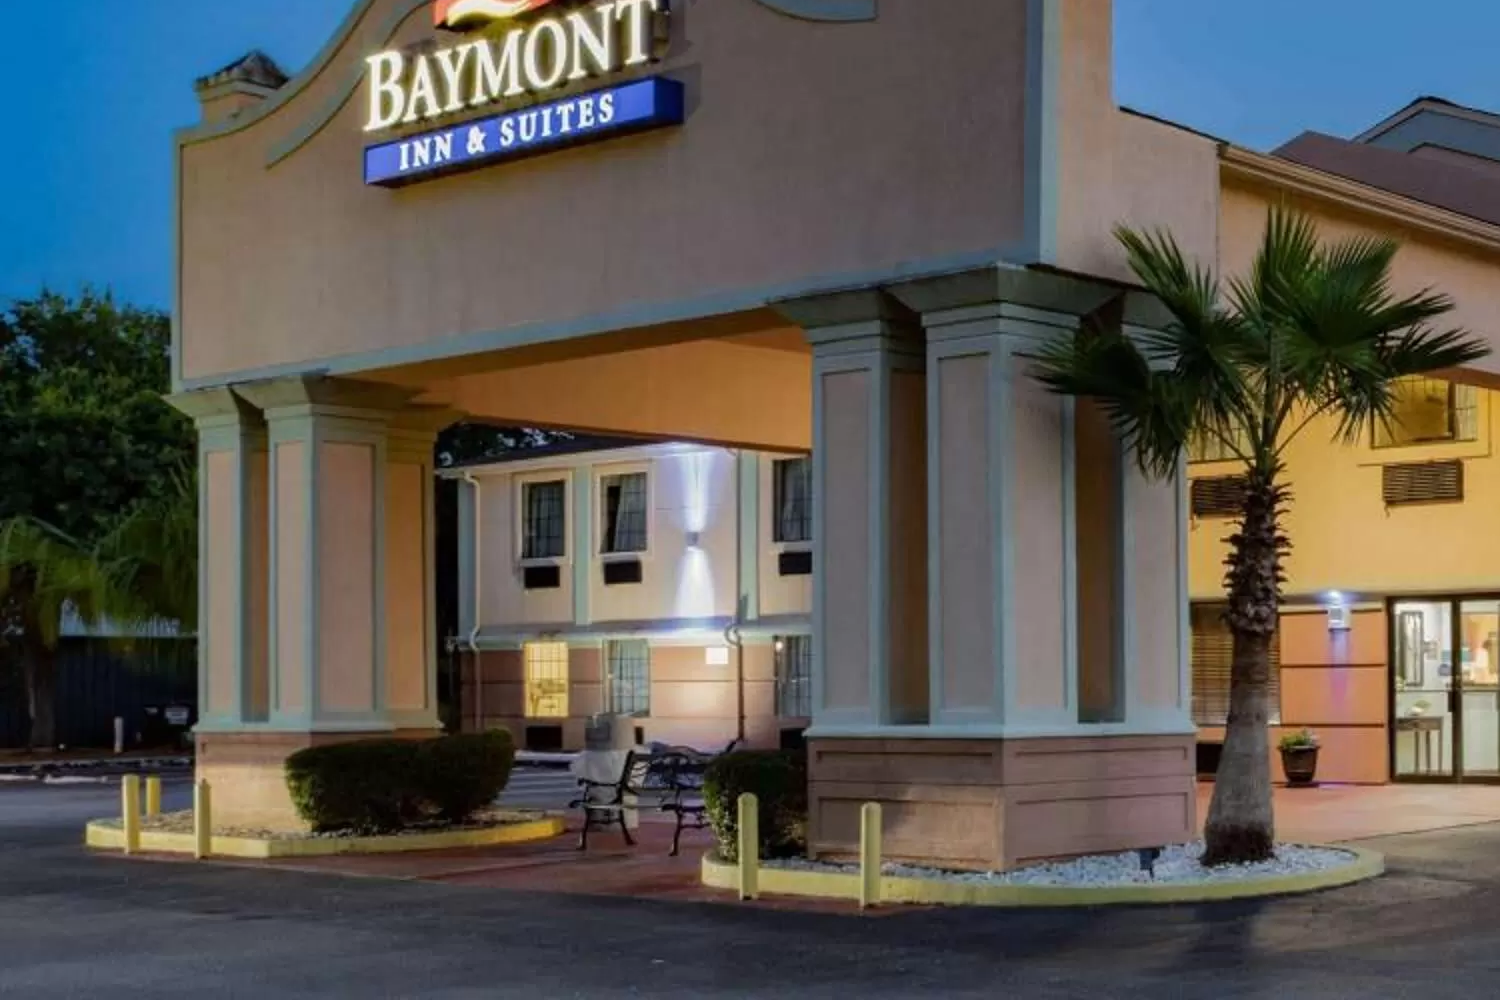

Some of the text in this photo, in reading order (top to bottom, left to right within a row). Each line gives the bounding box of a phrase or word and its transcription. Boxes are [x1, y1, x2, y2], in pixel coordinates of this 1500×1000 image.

[399, 93, 615, 171] INN & SUITES
